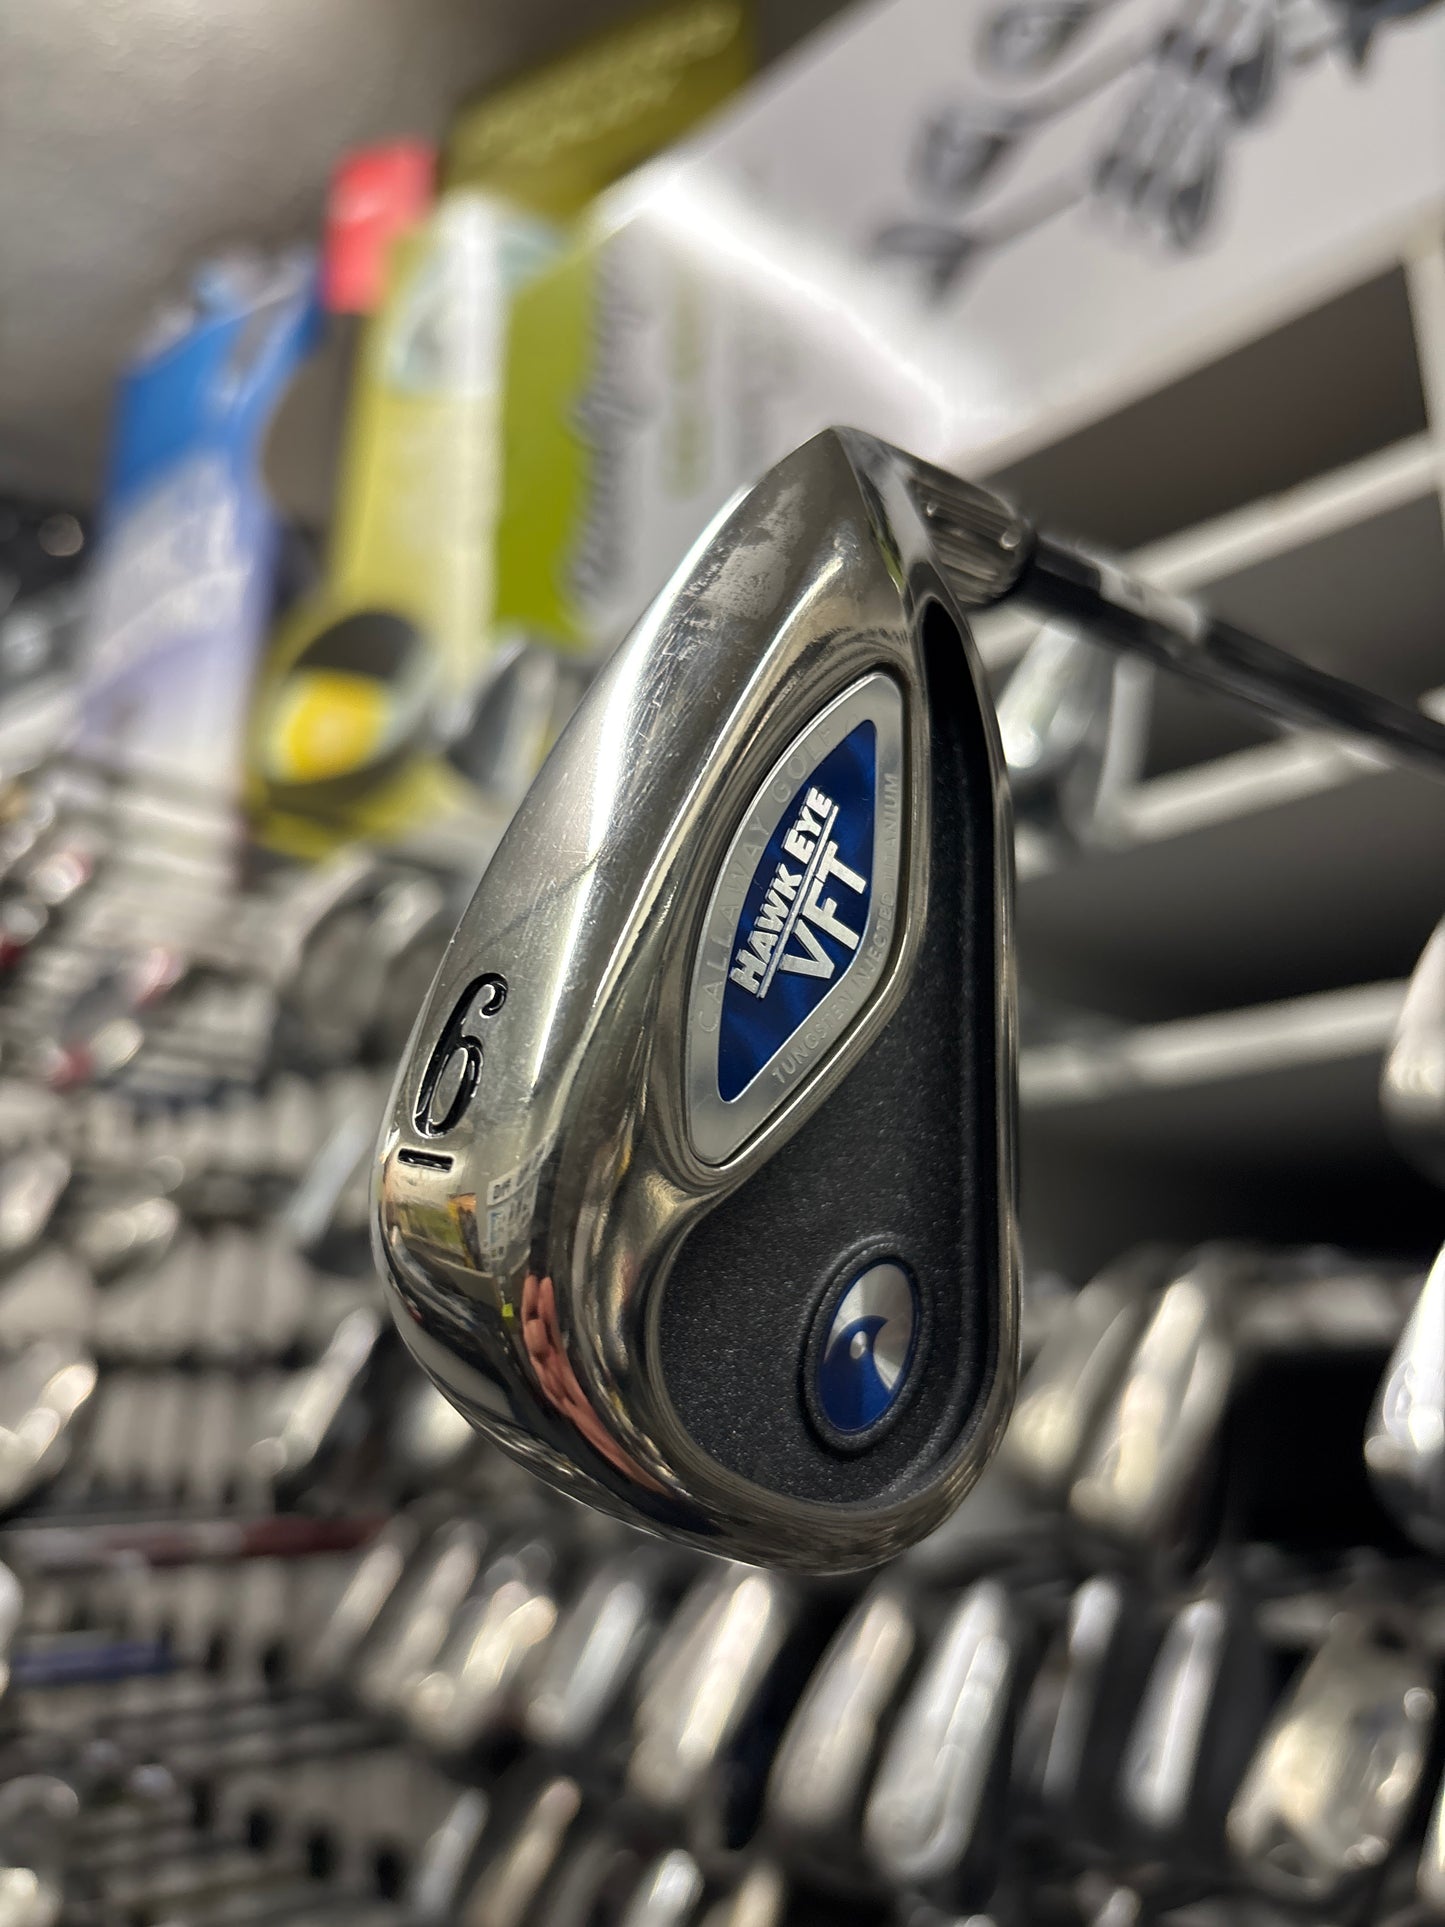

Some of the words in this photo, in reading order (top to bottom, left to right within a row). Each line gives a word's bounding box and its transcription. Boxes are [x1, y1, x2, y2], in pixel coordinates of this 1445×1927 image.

[700, 820, 769, 1033] CALLAWAY
[771, 725, 837, 804] GOLF
[729, 862, 802, 995] HAWK
[780, 786, 833, 866] EYE
[772, 993, 856, 1084] TUNGSTEN
[852, 891, 895, 990] INJECTED
[883, 772, 900, 882] TITANIUM
[777, 840, 868, 980] VFT
[413, 972, 509, 1139] 6
